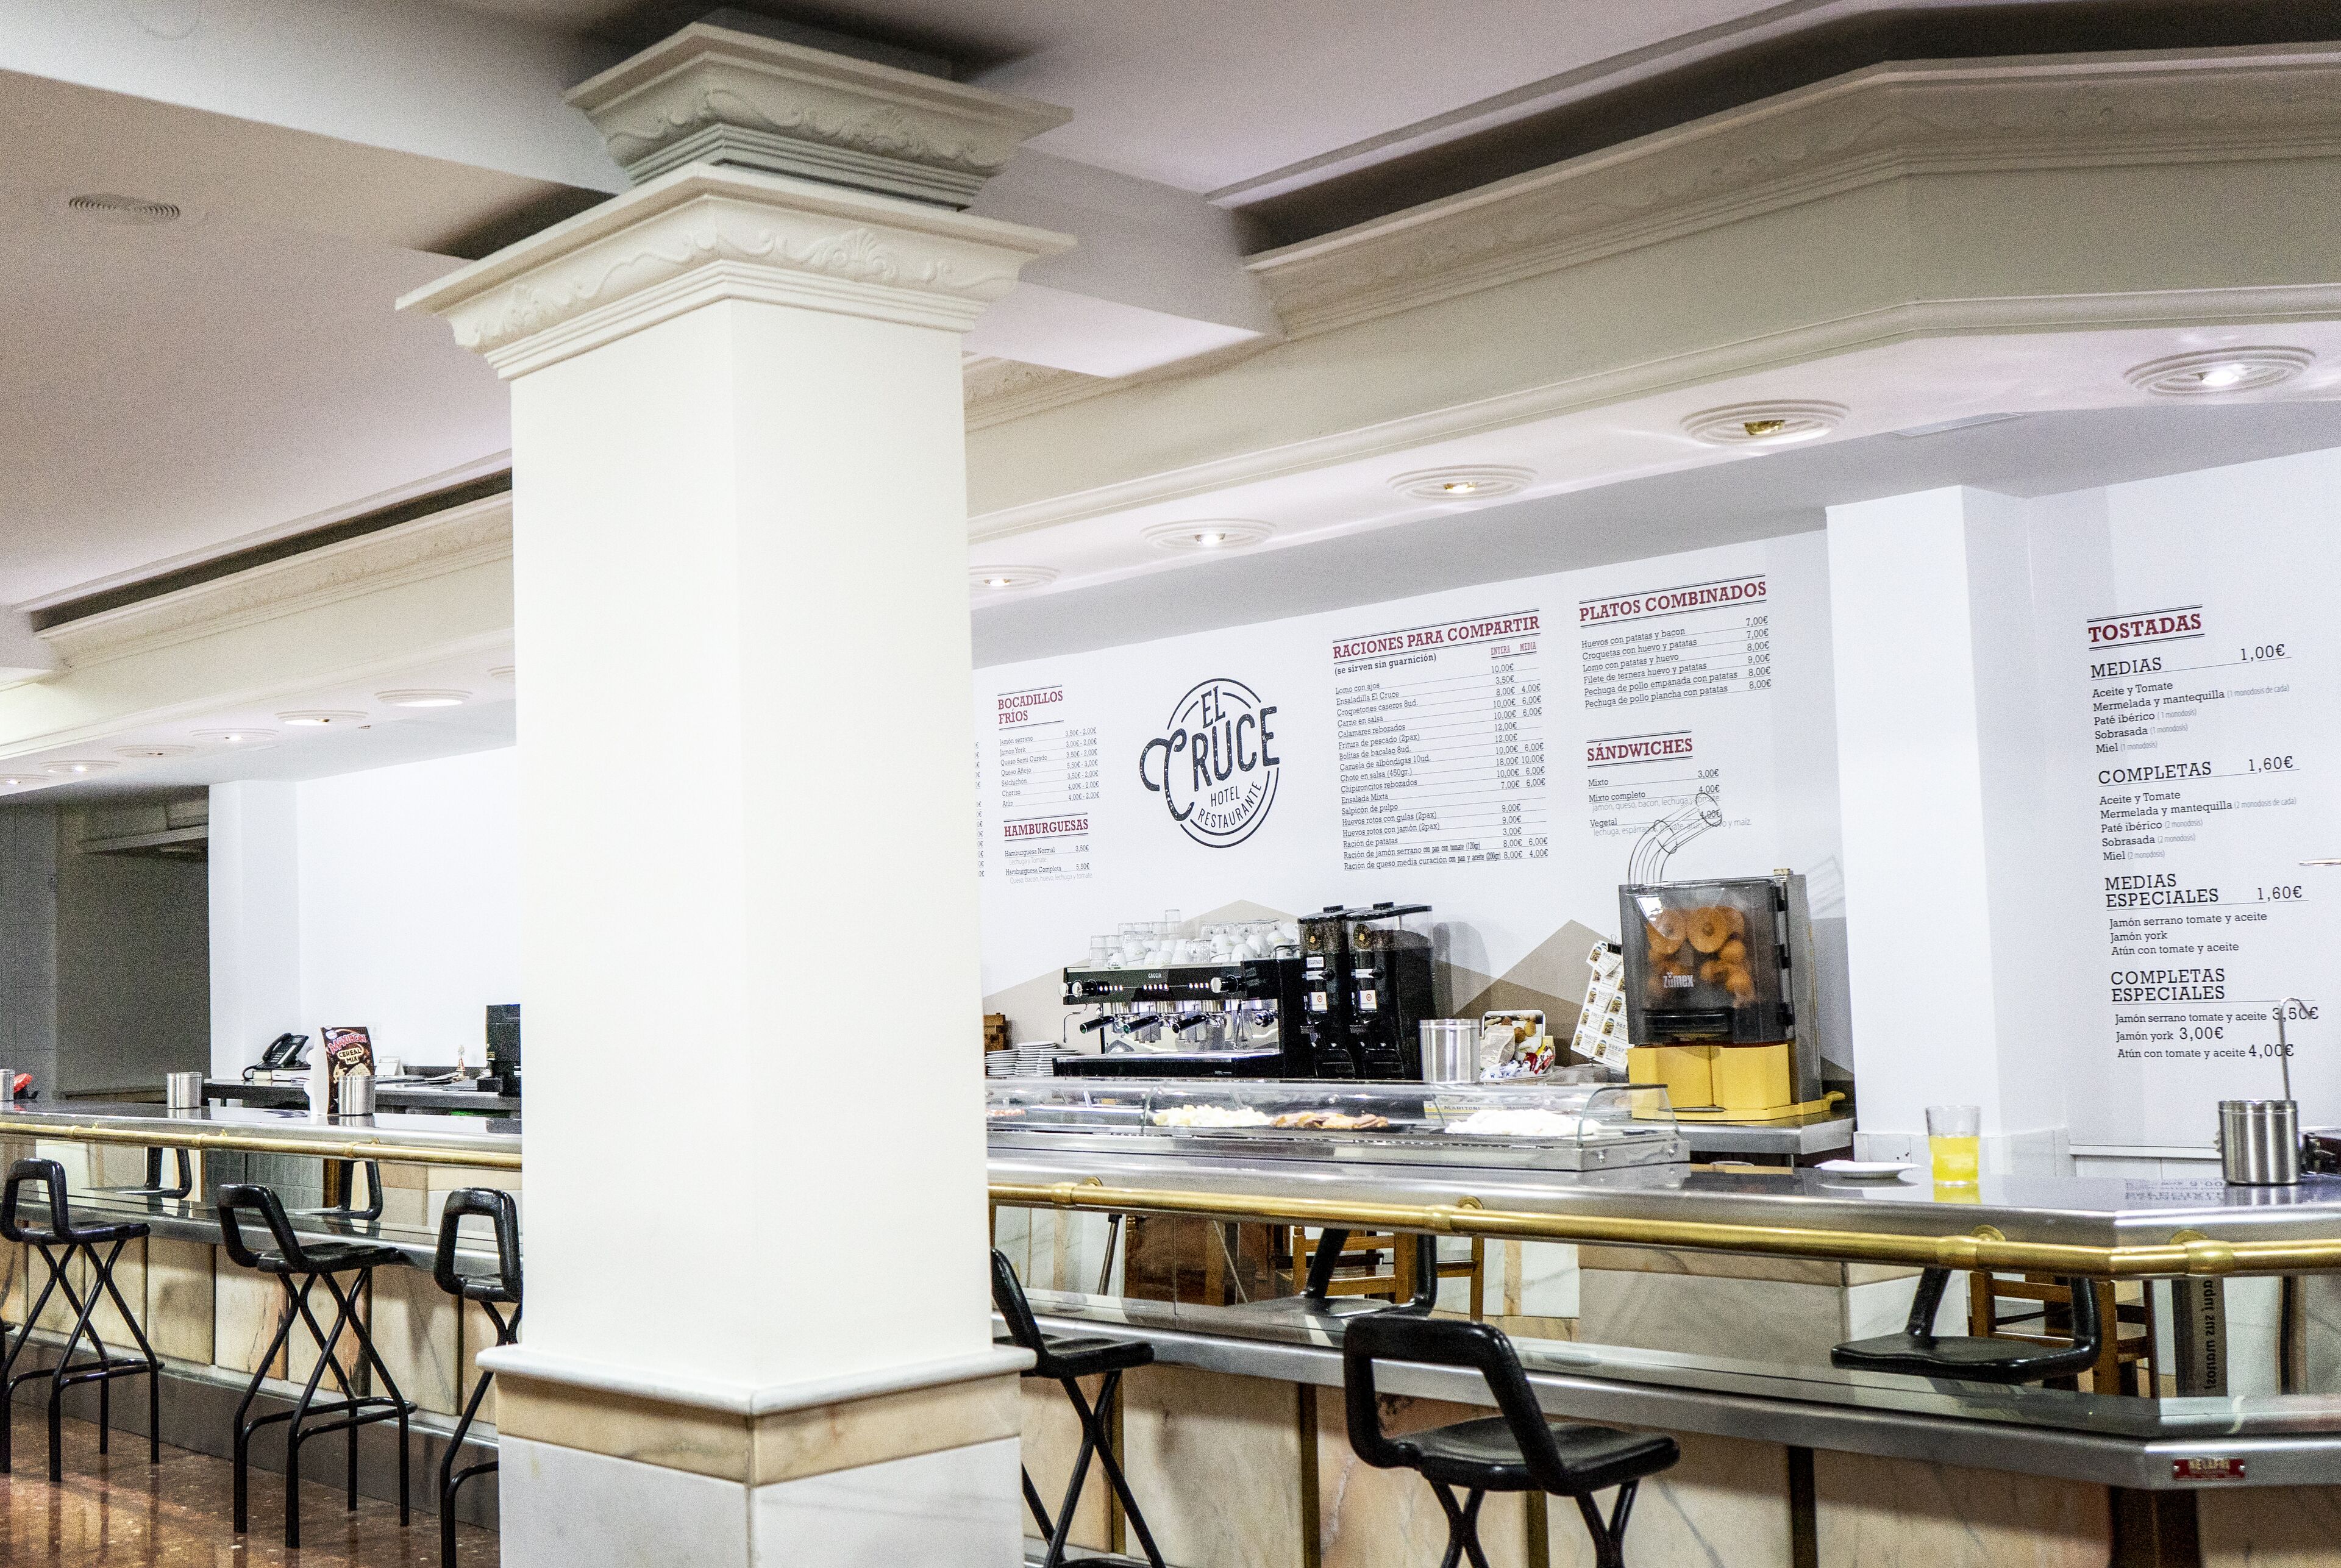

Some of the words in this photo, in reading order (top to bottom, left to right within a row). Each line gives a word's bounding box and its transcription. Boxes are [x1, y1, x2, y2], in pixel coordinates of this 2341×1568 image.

[1579, 599, 1641, 622] PLATOS
[1645, 582, 1766, 612] COMBINADOS
[1745, 616, 1768, 627] 7,00€
[1746, 628, 1769, 639] 7,00€
[2088, 615, 2201, 643] TOSTADAS
[1333, 635, 1403, 659] RACIONES
[1407, 630, 1444, 648] PARA
[1447, 615, 1539, 642] COMPARTIR
[1581, 639, 1608, 648] Huevos
[1625, 633, 1652, 644] patatas
[1661, 629, 1685, 638] bacon
[1491, 644, 1510, 655] ENTERA
[1519, 641, 1536, 652] MEDIA
[1582, 649, 1620, 660] Croquetas
[1637, 644, 1660, 653] huevo
[1662, 643, 1667, 652] y
[1669, 640, 1697, 650] patatas
[1747, 641, 1769, 652] 8,00€
[2242, 644, 2285, 661] 1,00€
[1334, 667, 1345, 676] (se
[1347, 665, 1372, 673] sirven
[1374, 661, 1386, 669] sin
[1388, 654, 1436, 669] guarnición)
[1620, 658, 1647, 669] patatas
[1656, 655, 1678, 663] huevo
[1747, 654, 1770, 664] 9,00€
[1583, 675, 1604, 684] Filete
[1606, 673, 1616, 682] de
[1617, 671, 1645, 680] ternera
[1678, 663, 1706, 674] patatas
[2092, 657, 2161, 678] MEDIAS
[1367, 682, 1380, 691] ajos
[2092, 688, 2125, 699] Aceite
[2126, 688, 2133, 697] y
[2135, 682, 2173, 694] Tomate
[998, 690, 1063, 710] BOCADILLOS
[1336, 694, 1370, 705] Ensaladilla
[2093, 698, 2151, 712] Mermelada
[2153, 699, 2160, 708] y
[2162, 690, 2225, 705] mantequilla
[1201, 685, 1225, 729] EL
[1336, 706, 1377, 716] Croquetones
[998, 708, 1028, 724] FRÍOS
[2094, 715, 2115, 725] Paté
[2117, 713, 2154, 723] ibérico
[1338, 729, 1370, 738] Calamares
[1372, 724, 1405, 734] rebozados
[2095, 727, 2148, 740] Sobrasada
[999, 738, 1014, 746] Jamón
[2096, 743, 2118, 754] Miel
[1587, 739, 1692, 761] SÁNDWICHES
[1016, 756, 1028, 764] Semi
[1029, 754, 1047, 763] Curado
[1139, 706, 1280, 821] CRUCE
[2250, 756, 2293, 772] 1,60€
[1698, 769, 1719, 779] 3,00€
[2098, 762, 2211, 784] COMPLETAS
[1001, 777, 1027, 786] Salchichón
[1341, 783, 1383, 794] Chipironcitos
[1384, 779, 1417, 789] rebozados
[1588, 779, 1608, 787] Mixto
[1211, 785, 1240, 807] HOTEL
[1611, 791, 1645, 801] completo
[1698, 785, 1720, 794] 4,00€
[1198, 781, 1262, 829] RESTAURANTE
[2099, 795, 2131, 805] Aceite
[2134, 796, 2140, 805] y
[2142, 791, 2180, 802] Tomate
[1341, 806, 1368, 816] Salpicón
[1379, 804, 1398, 813] pulpo
[2100, 807, 2158, 819] Mermelada
[2161, 808, 2167, 816] y
[2170, 801, 2232, 814] mantequilla
[1004, 819, 1088, 837] HAMBURGUESAS
[1590, 818, 1617, 828] Vegetal
[2101, 823, 2123, 833] Paté
[2125, 821, 2162, 831] ibérico
[1375, 838, 1398, 847] patatas
[2101, 835, 2155, 847] Sobrasada
[2103, 851, 2125, 861] Miel
[1038, 865, 1061, 874] Completa
[2106, 874, 2176, 891] MEDIAS
[2107, 889, 2218, 908] ESPECIALES
[2259, 886, 2302, 901] 1,60€
[2110, 918, 2141, 929] Jamón
[2186, 915, 2222, 924] tomate
[2224, 916, 2231, 924] y
[2234, 912, 2267, 922] aceite
[2111, 932, 2141, 943] Jamón
[2143, 930, 2167, 942] york
[2111, 946, 2135, 955] Atún
[2159, 945, 2194, 953] tomate
[2197, 946, 2204, 954] y
[2207, 943, 2239, 952] aceite
[2111, 969, 2225, 985] COMPLETAS
[2112, 986, 2225, 1002] ESPECIALES
[2115, 1014, 2146, 1025] Jamón
[2189, 1014, 2223, 1022] tomate
[2225, 1015, 2232, 1024] y
[2235, 1012, 2267, 1021] aceite
[2117, 1032, 2148, 1042] Jamón
[2150, 1032, 2173, 1042] york
[2179, 1027, 2223, 1041] 3,00€
[327, 1034, 367, 1055] MAXIBON
[2248, 1044, 2294, 1058] 4,00€
[339, 1049, 362, 1058] CEREAL
[2117, 1049, 2141, 1058] Atún
[2213, 1049, 2245, 1057] aceite
